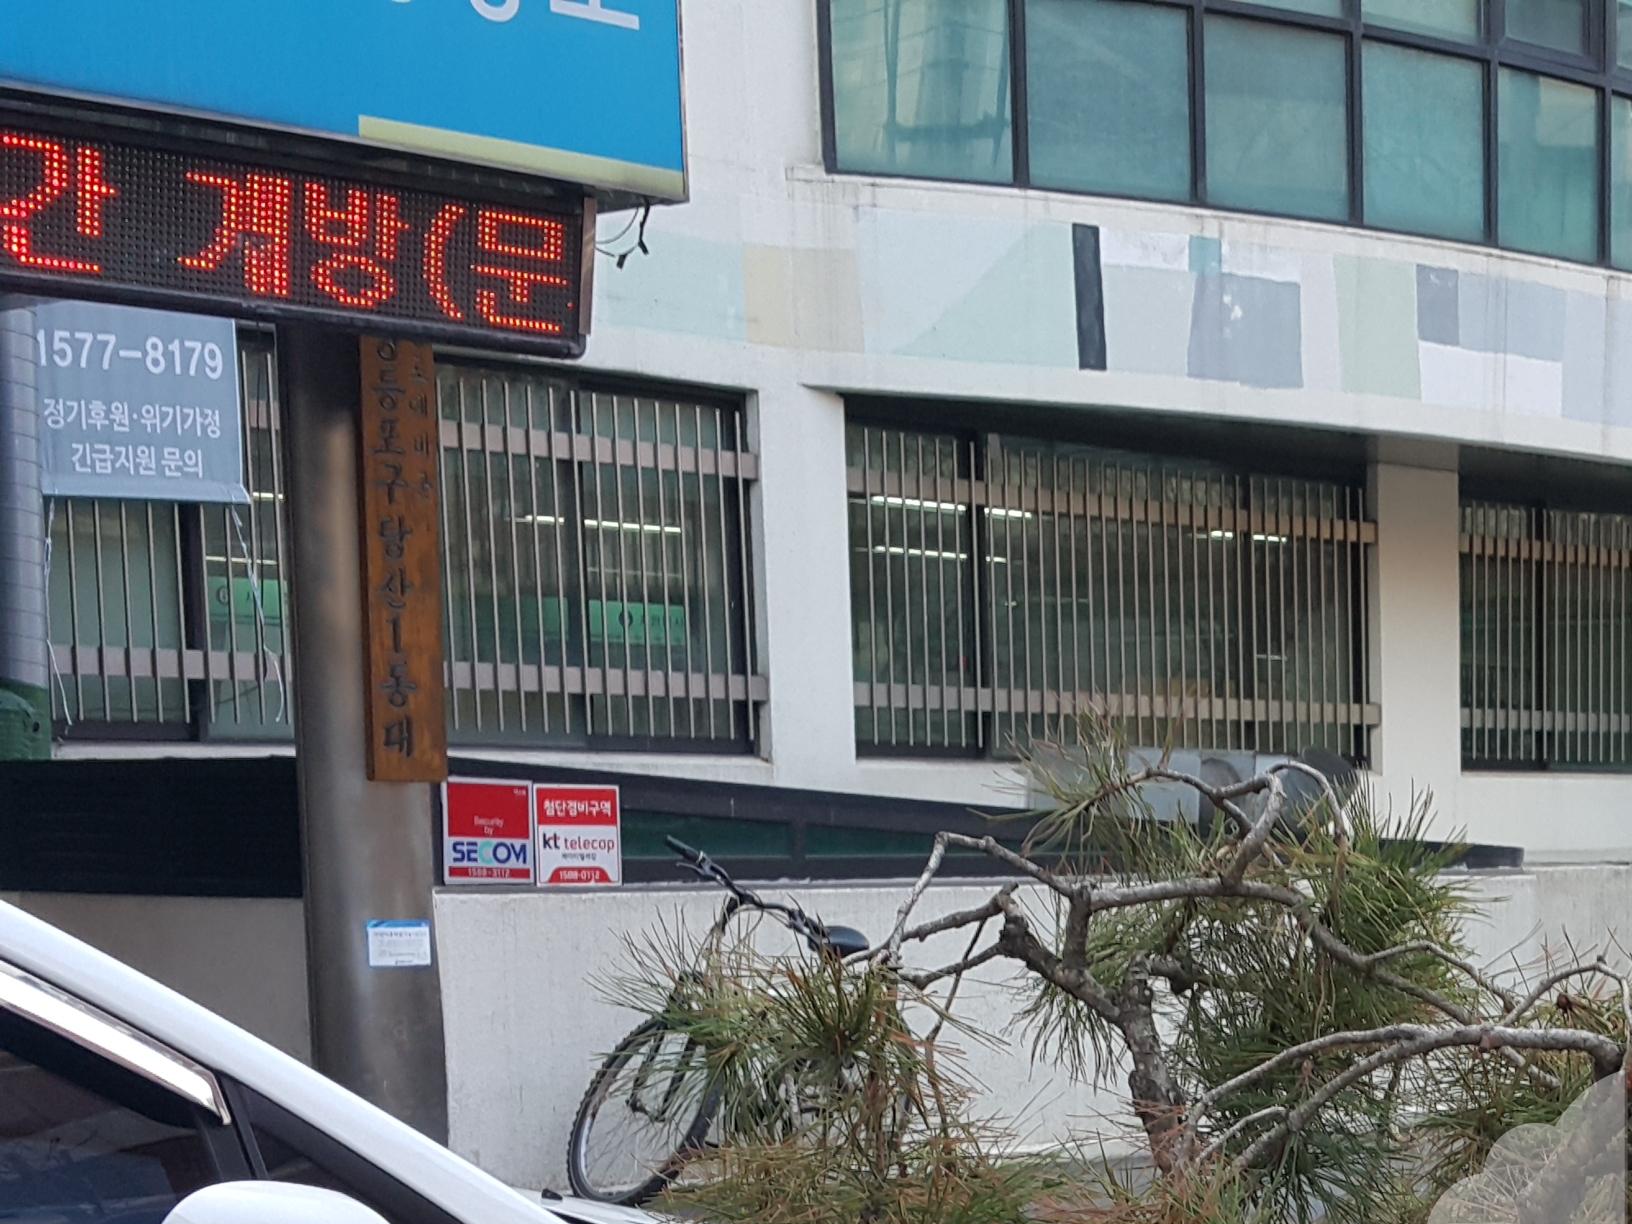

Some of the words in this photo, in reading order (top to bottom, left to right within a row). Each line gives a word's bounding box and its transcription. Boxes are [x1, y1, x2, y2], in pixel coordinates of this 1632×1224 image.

[36, 328, 223, 380] 1577-8179
[71, 443, 156, 476] 긴급지원
[160, 447, 203, 478] 문의
[543, 798, 612, 817] 첨단경비구역
[452, 840, 527, 864] SECOM
[543, 832, 560, 850] kt
[564, 836, 615, 853] telecop
